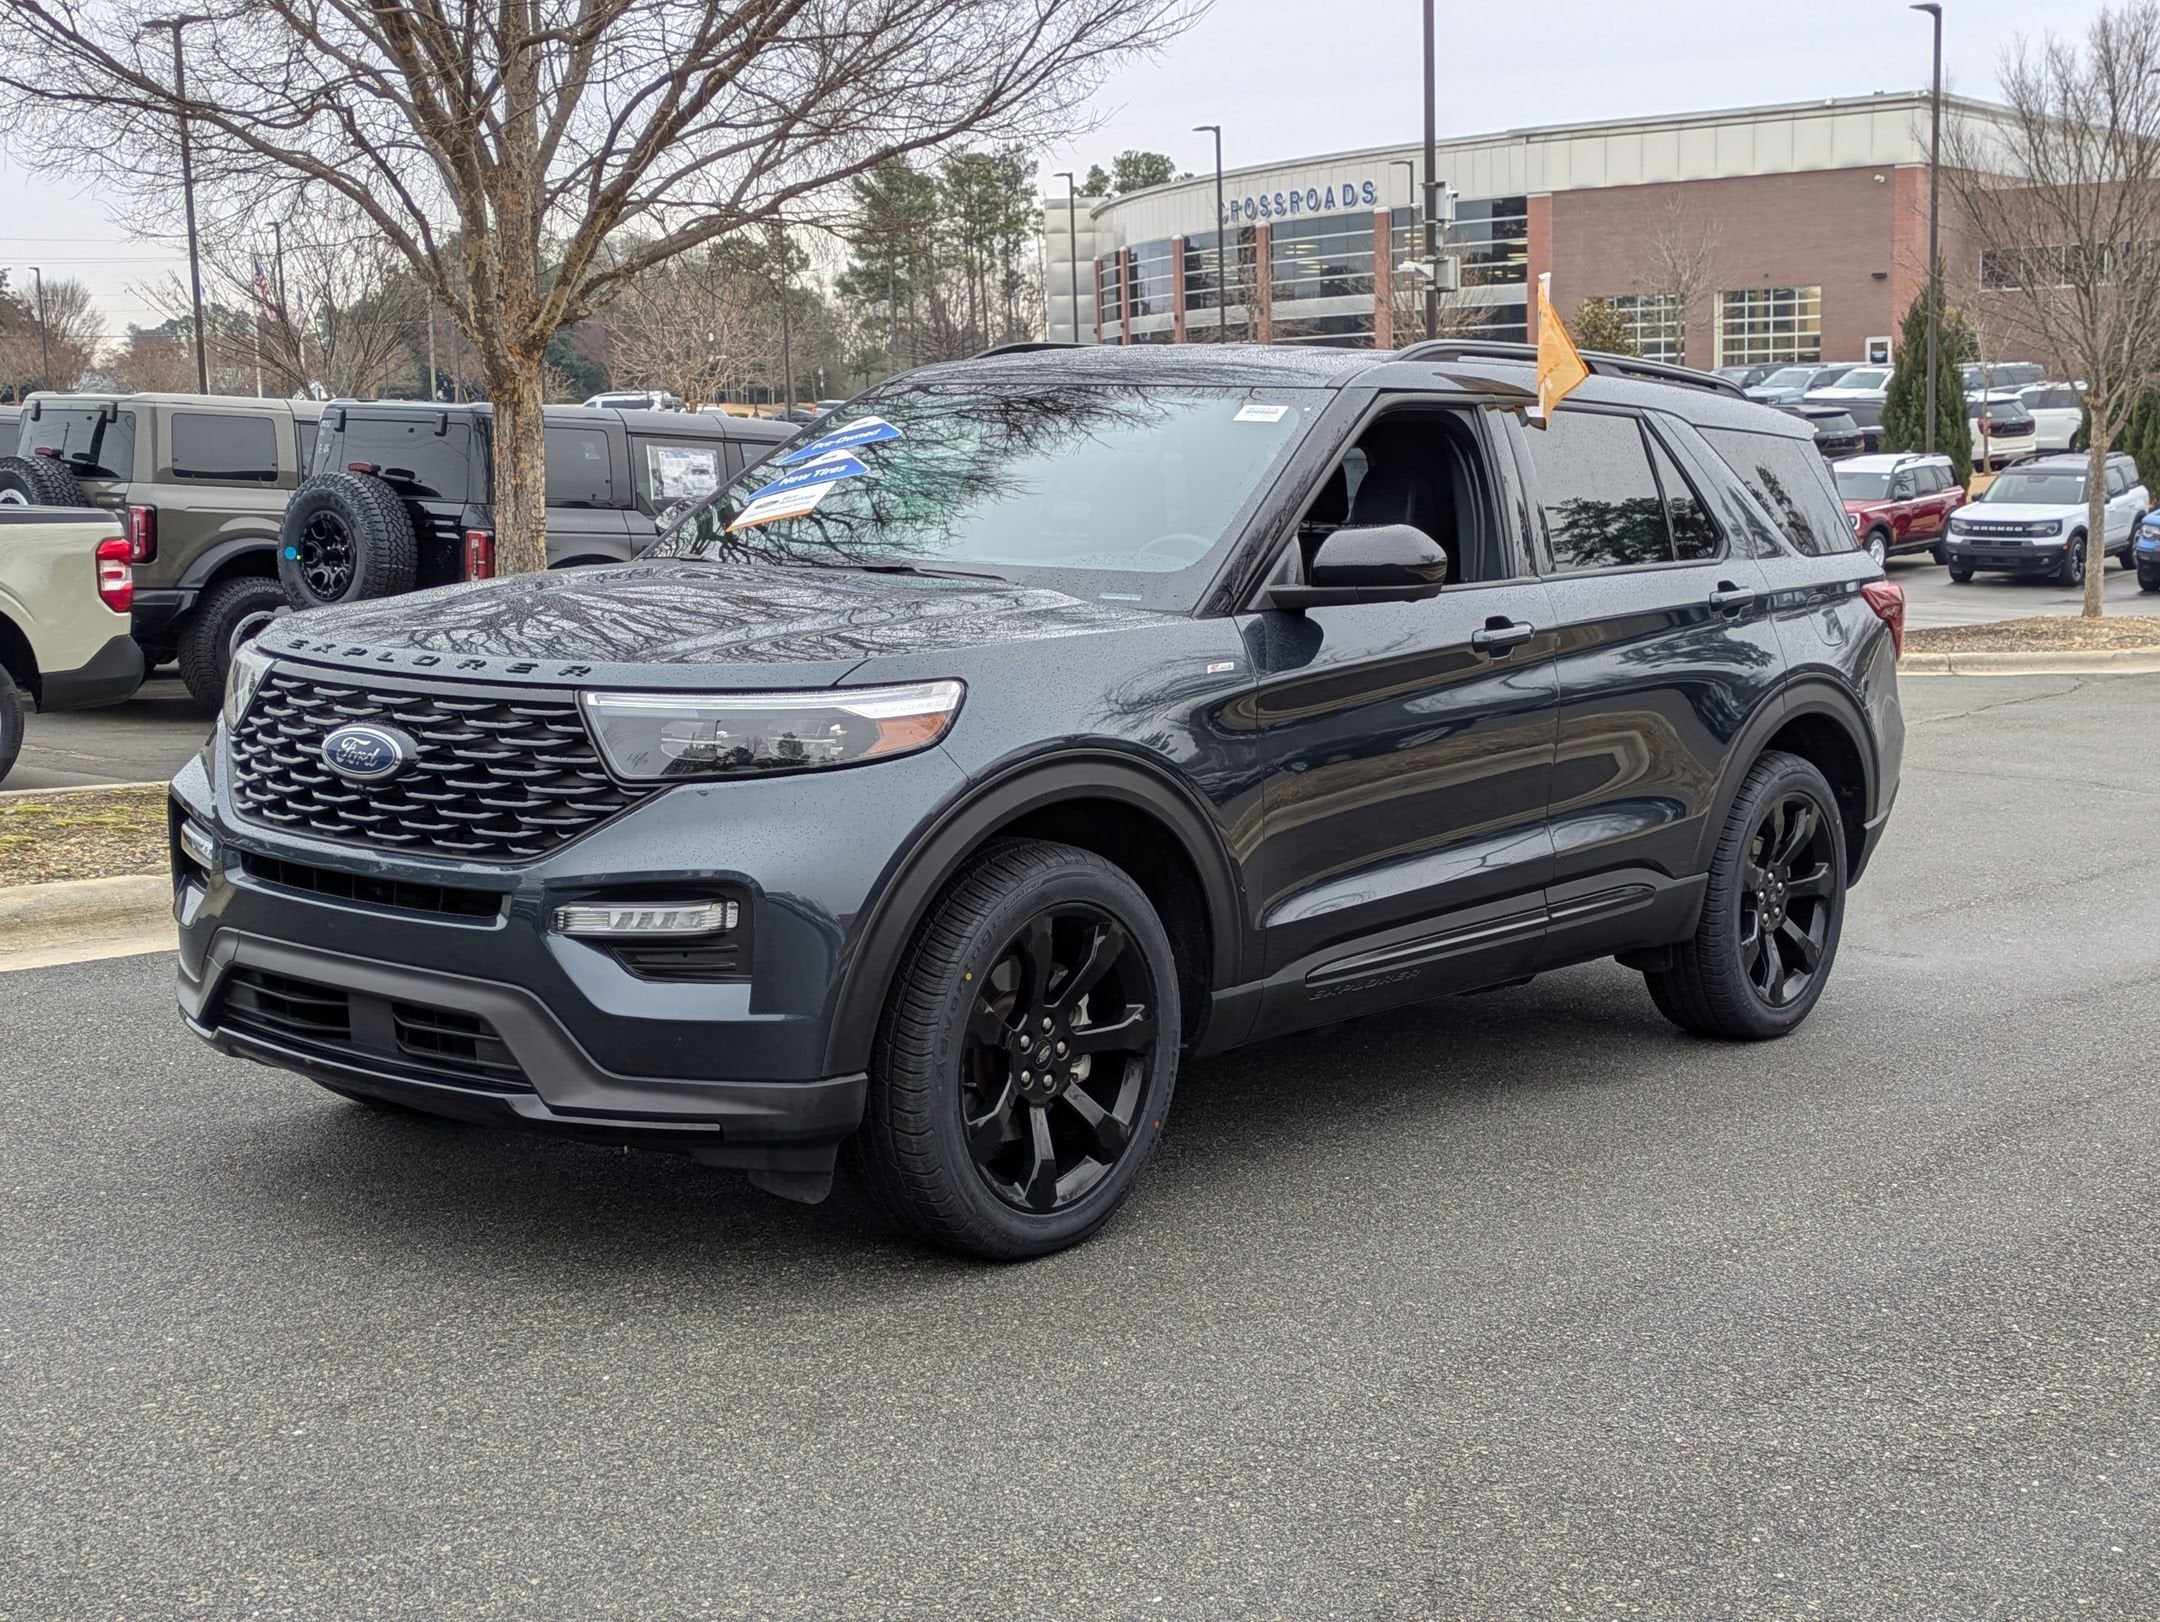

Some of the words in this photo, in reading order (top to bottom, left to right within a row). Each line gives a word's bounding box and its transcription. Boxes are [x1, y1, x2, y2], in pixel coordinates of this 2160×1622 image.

[811, 428, 882, 451] Pre-Owned
[778, 473, 812, 487] New
[812, 464, 848, 478] Tires
[286, 638, 592, 678] EXPLORER
[335, 736, 381, 768] Ford
